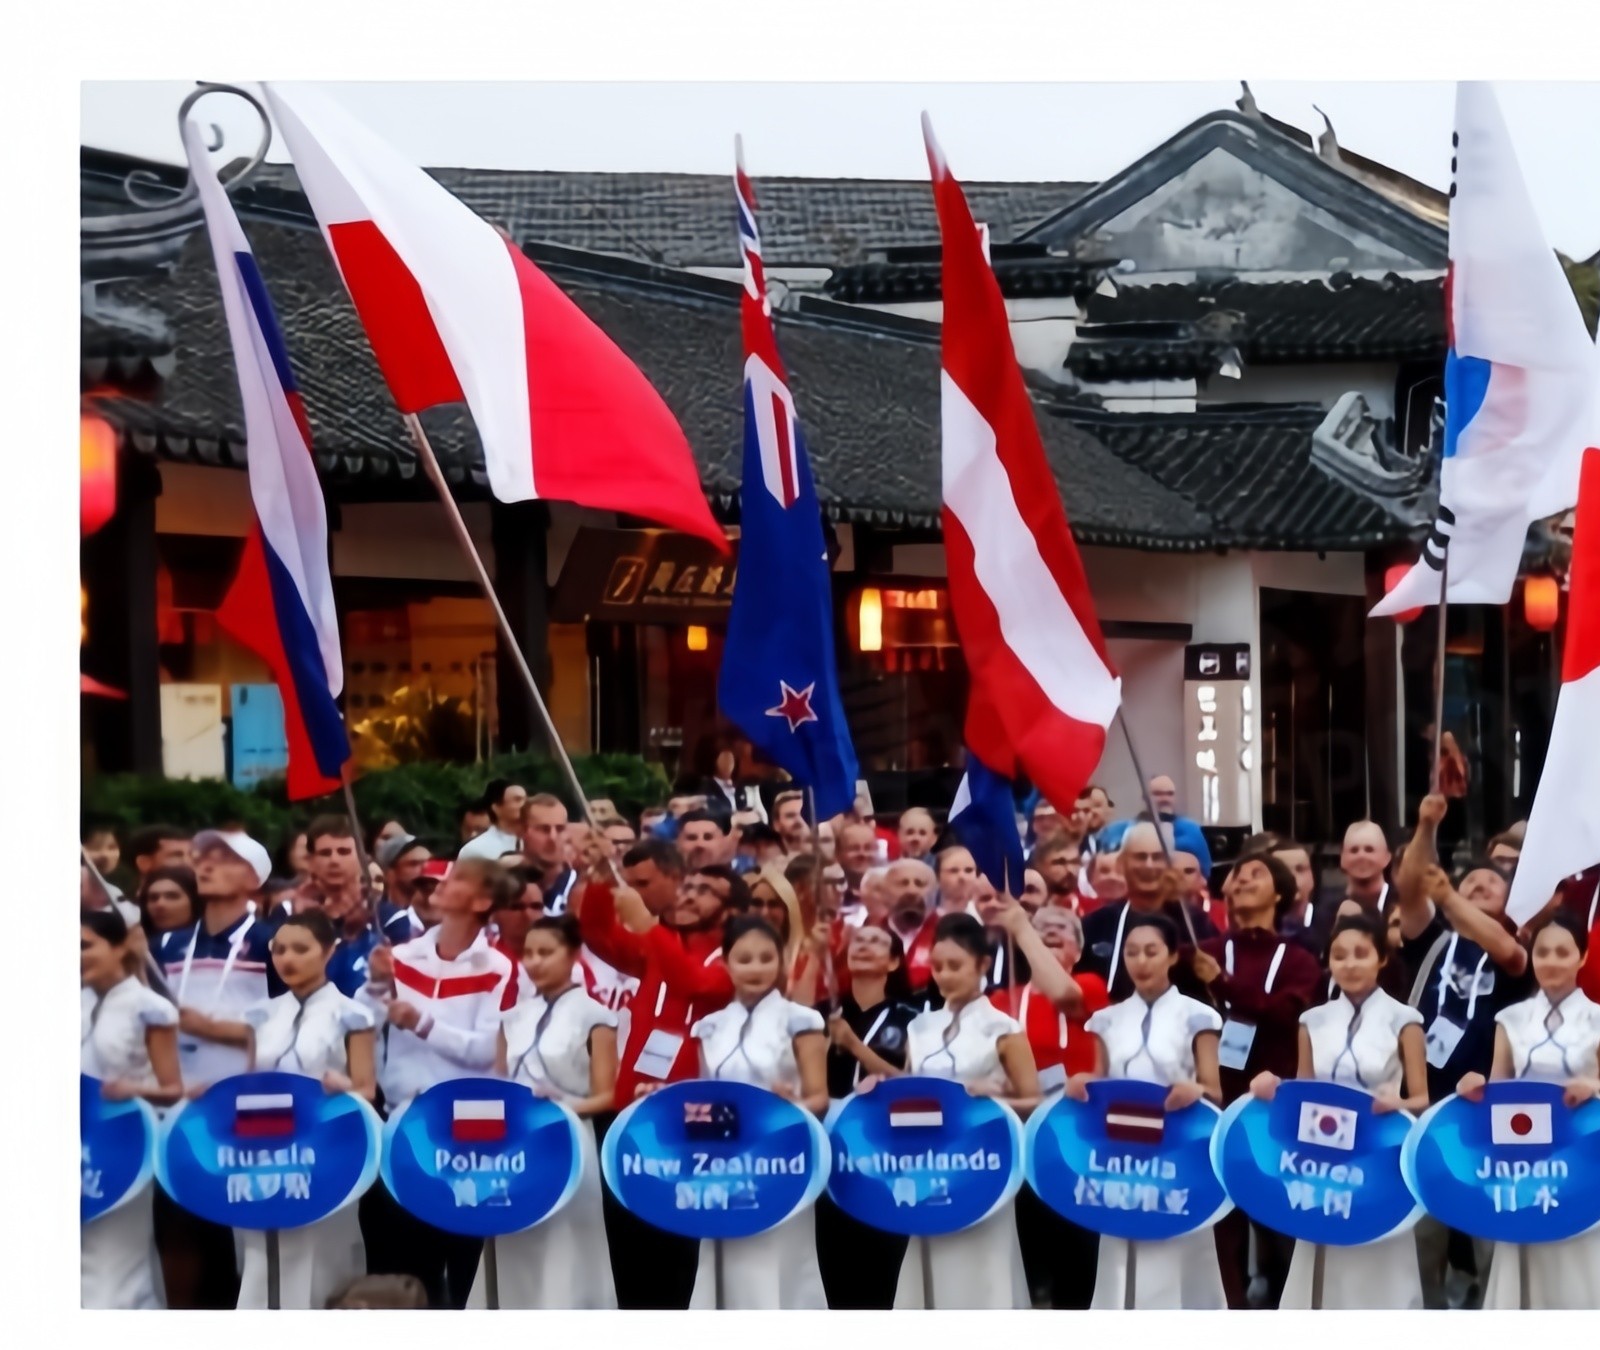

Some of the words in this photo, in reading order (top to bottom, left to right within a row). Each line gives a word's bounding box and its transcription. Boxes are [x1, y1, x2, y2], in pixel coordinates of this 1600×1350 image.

[218, 1142, 316, 1168] Russia
[435, 1149, 526, 1174] Poland
[622, 1153, 680, 1176] New
[692, 1151, 806, 1176] Zealand
[838, 1148, 1001, 1174] Netherlands
[1088, 1149, 1177, 1179] Latvia
[1279, 1150, 1365, 1186] Korea
[1476, 1155, 1568, 1182] Japan
